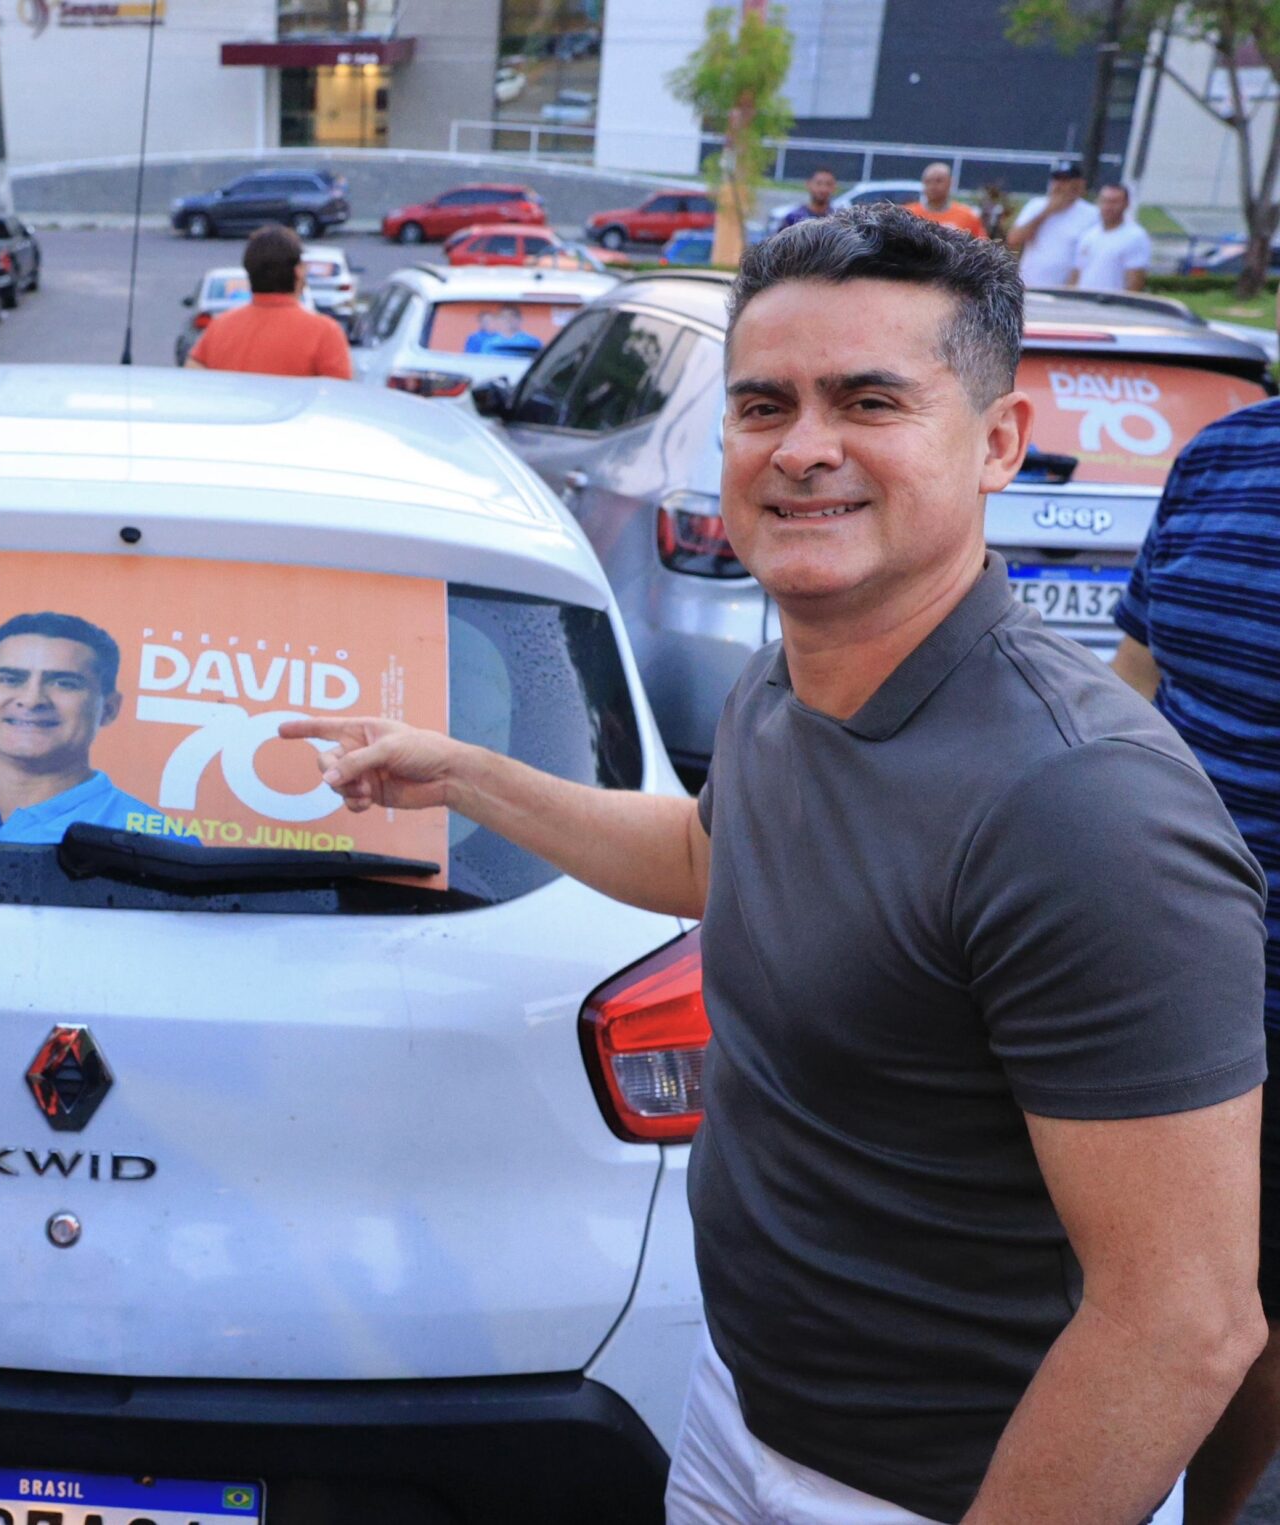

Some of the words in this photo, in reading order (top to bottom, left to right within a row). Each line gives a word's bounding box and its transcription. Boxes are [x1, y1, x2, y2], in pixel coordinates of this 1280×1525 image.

[1049, 371, 1161, 404] DAVID
[1056, 397, 1173, 457] 70
[1034, 502, 1113, 535] Jeep
[143, 627, 349, 661] PREFEITO
[138, 643, 361, 711] DAVID
[135, 695, 350, 822] 70
[125, 812, 243, 843] RENATO
[247, 825, 355, 852] JUNIOR
[19, 1478, 85, 1499] BRASIL
